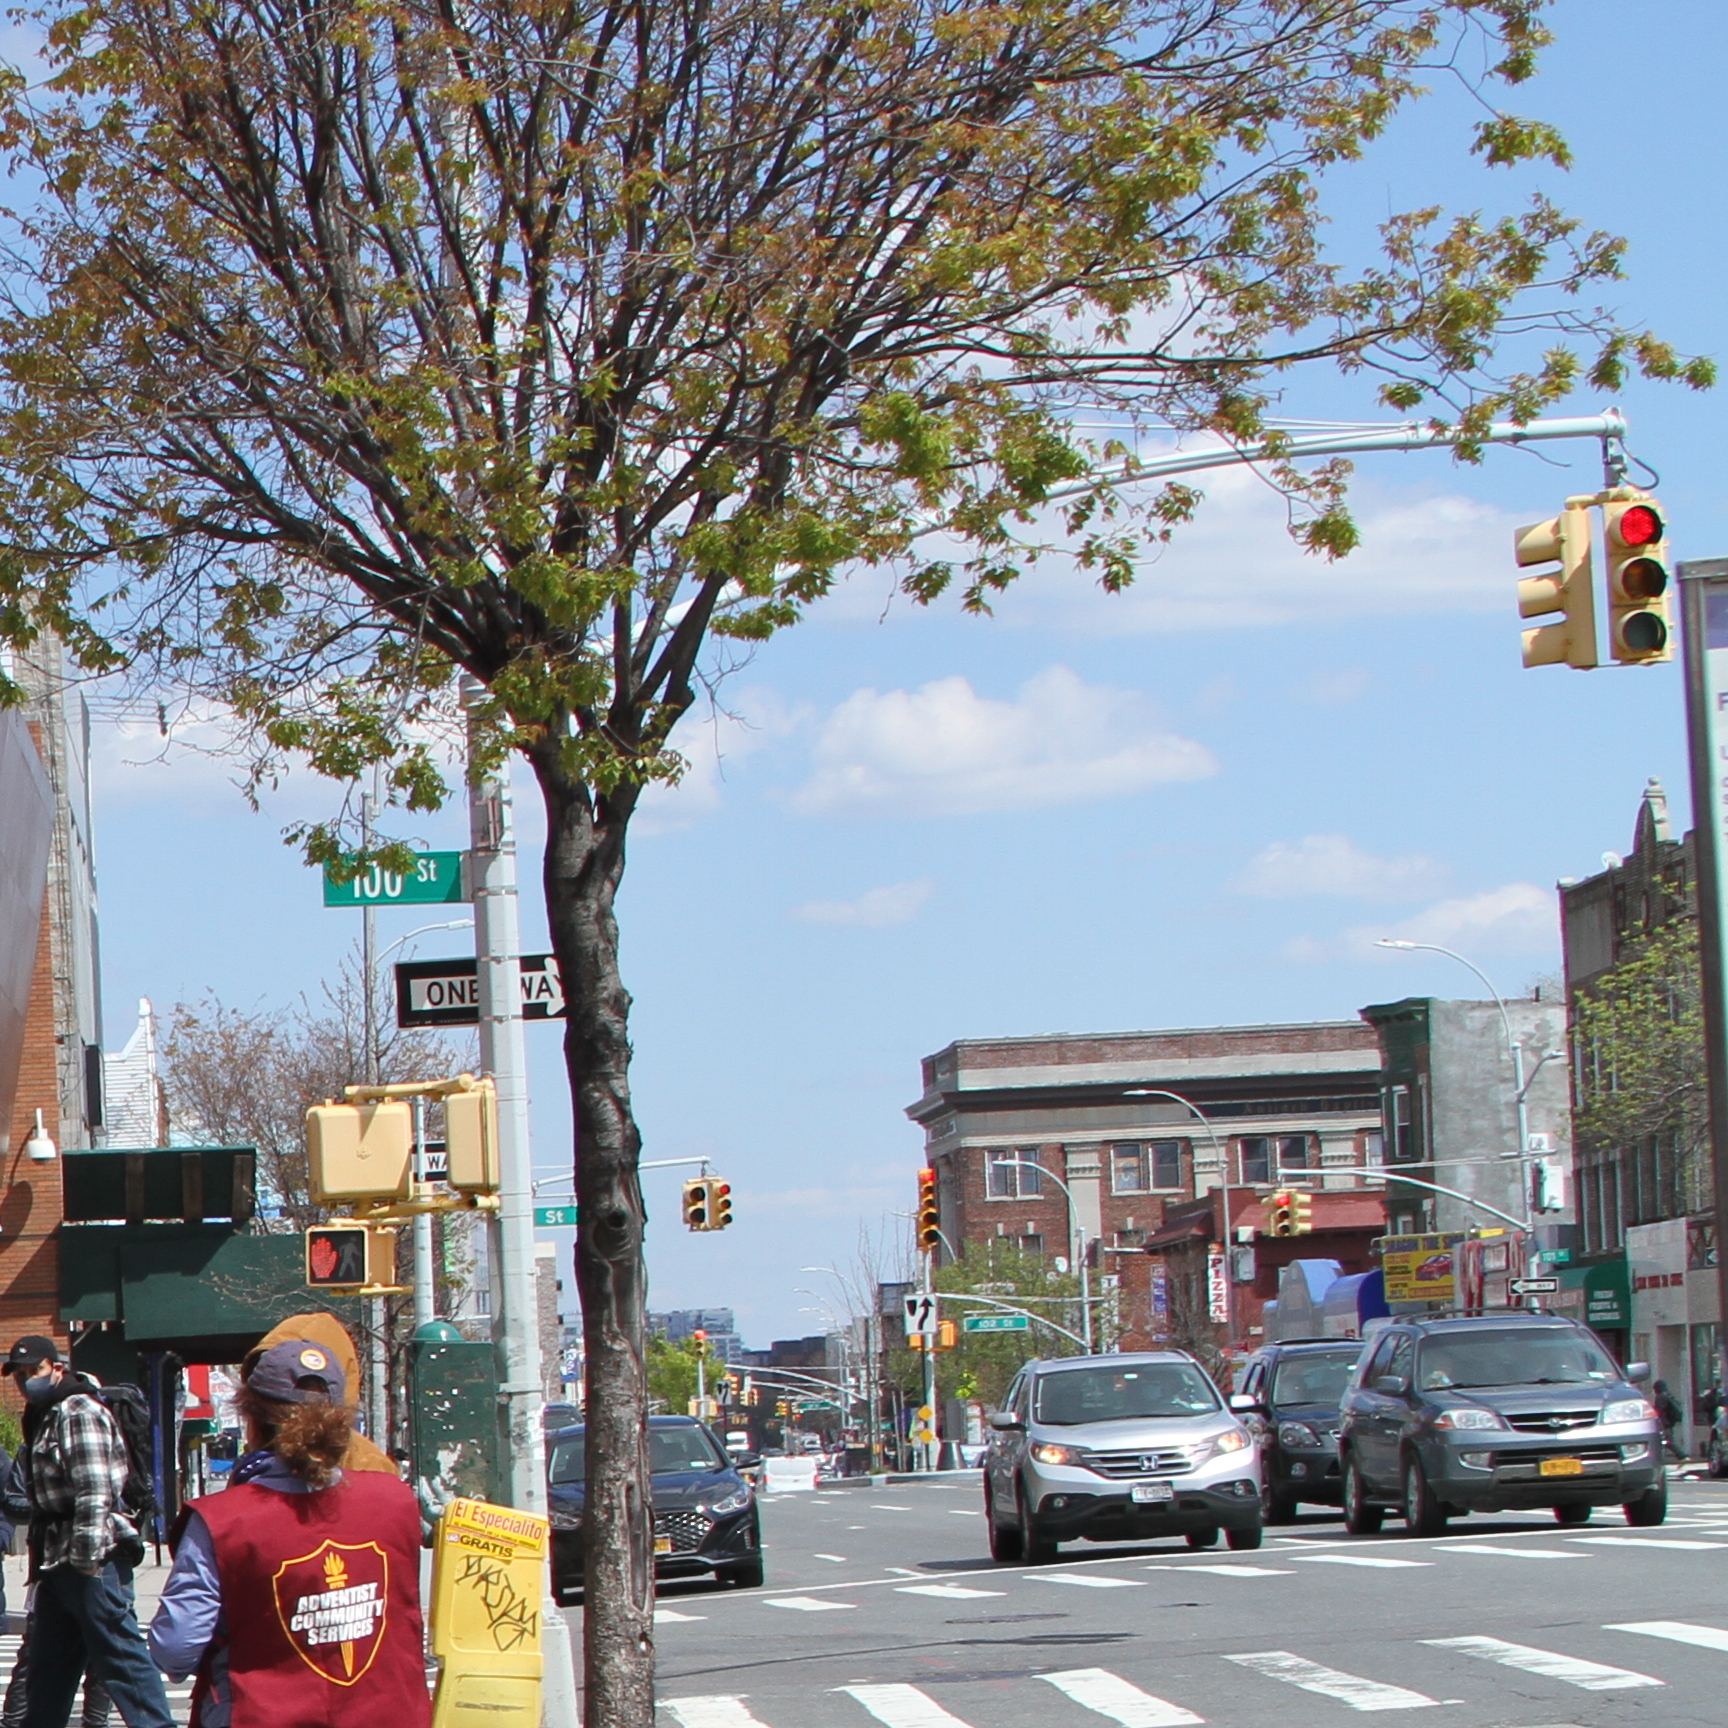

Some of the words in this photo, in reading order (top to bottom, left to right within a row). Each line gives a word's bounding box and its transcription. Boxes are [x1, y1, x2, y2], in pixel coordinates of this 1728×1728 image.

[353, 860, 403, 898] 100
[416, 858, 437, 882] St
[427, 978, 479, 1006] ONE
[545, 1210, 565, 1224] St
[1210, 1257, 1228, 1314] PIZZA
[977, 1320, 997, 1328] 102
[1003, 1319, 1014, 1328] St
[455, 1501, 468, 1518] El
[471, 1505, 542, 1540] Especialito
[460, 1534, 514, 1557] GRATIS
[296, 1582, 378, 1614] ADVENTIST
[290, 1598, 384, 1632] COMMUNITY
[307, 1618, 374, 1646] SERVICES
